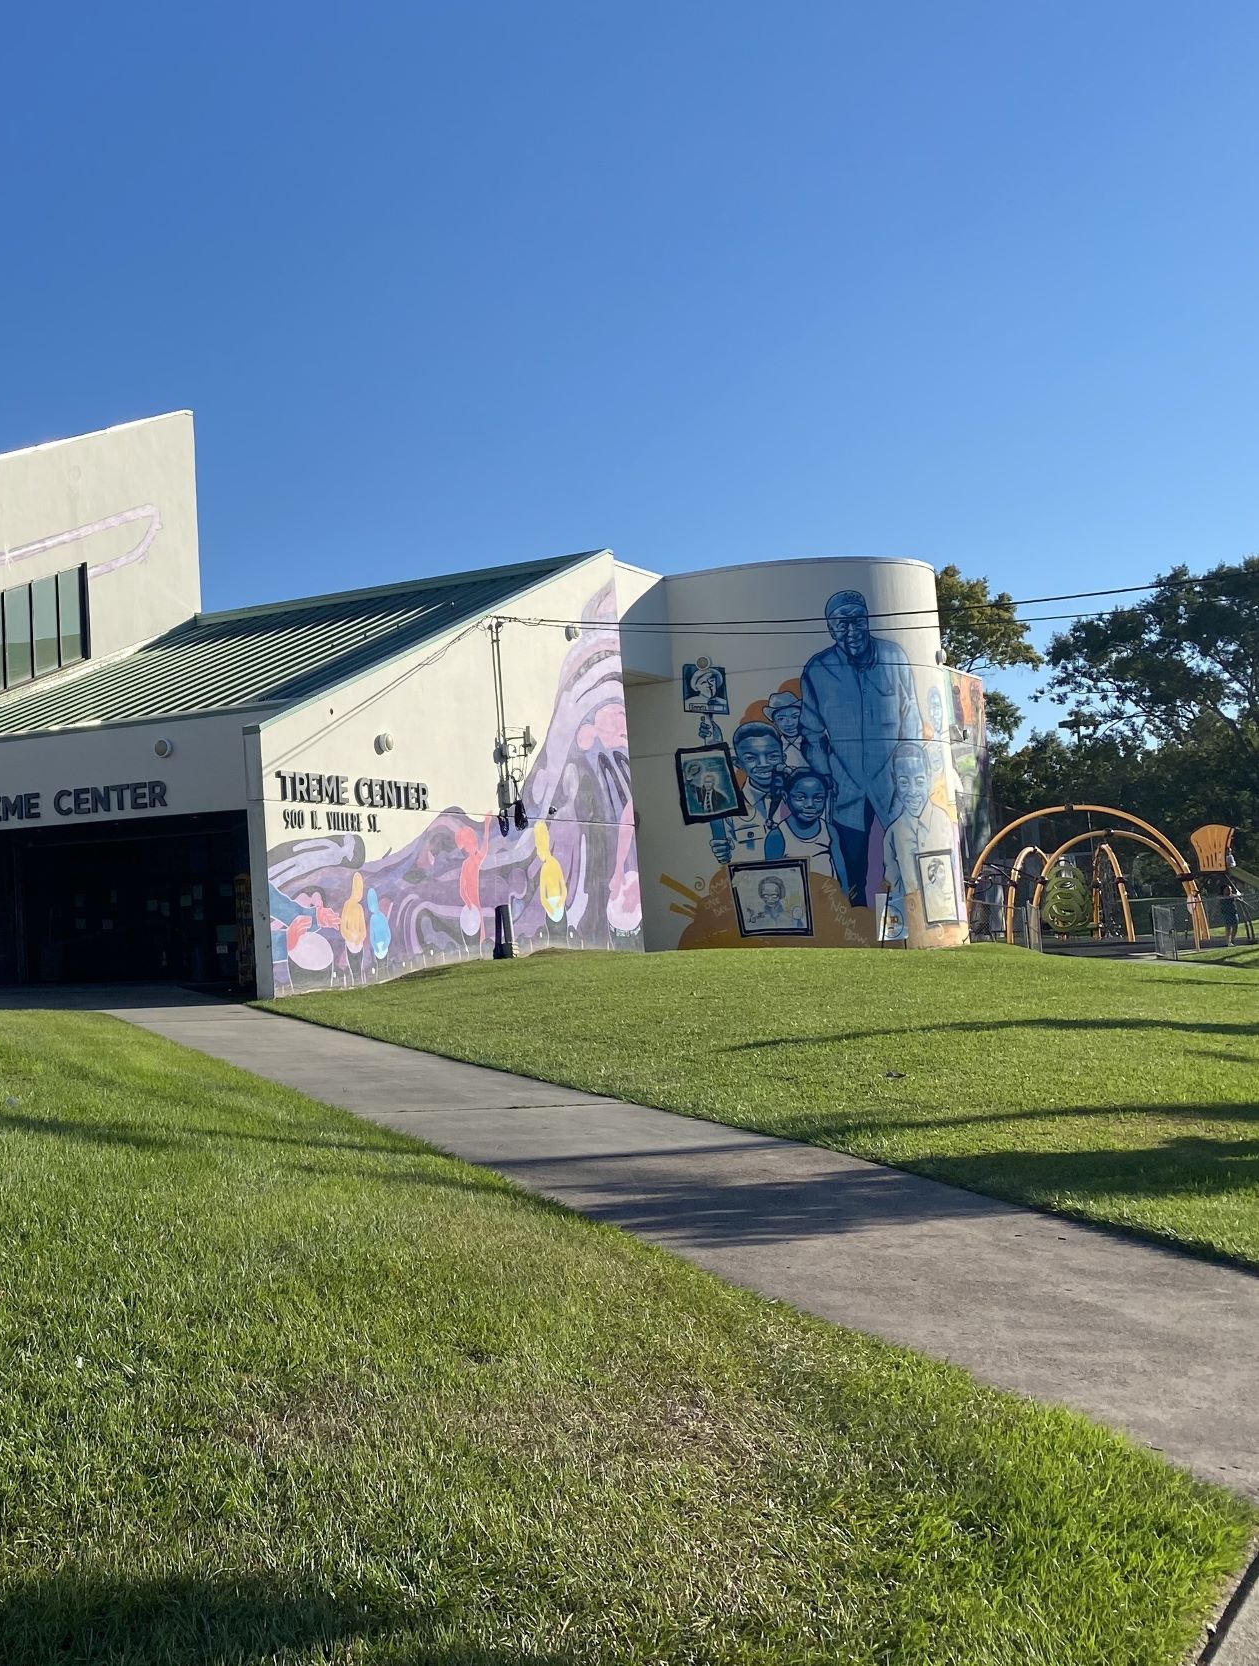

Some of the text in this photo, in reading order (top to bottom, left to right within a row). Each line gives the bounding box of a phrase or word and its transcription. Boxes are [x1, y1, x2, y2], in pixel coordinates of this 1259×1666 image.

[53, 780, 168, 817] CENTER
[275, 770, 430, 811] TREME CENTER
[282, 809, 305, 830] 900
[326, 811, 362, 832] VILLERE
